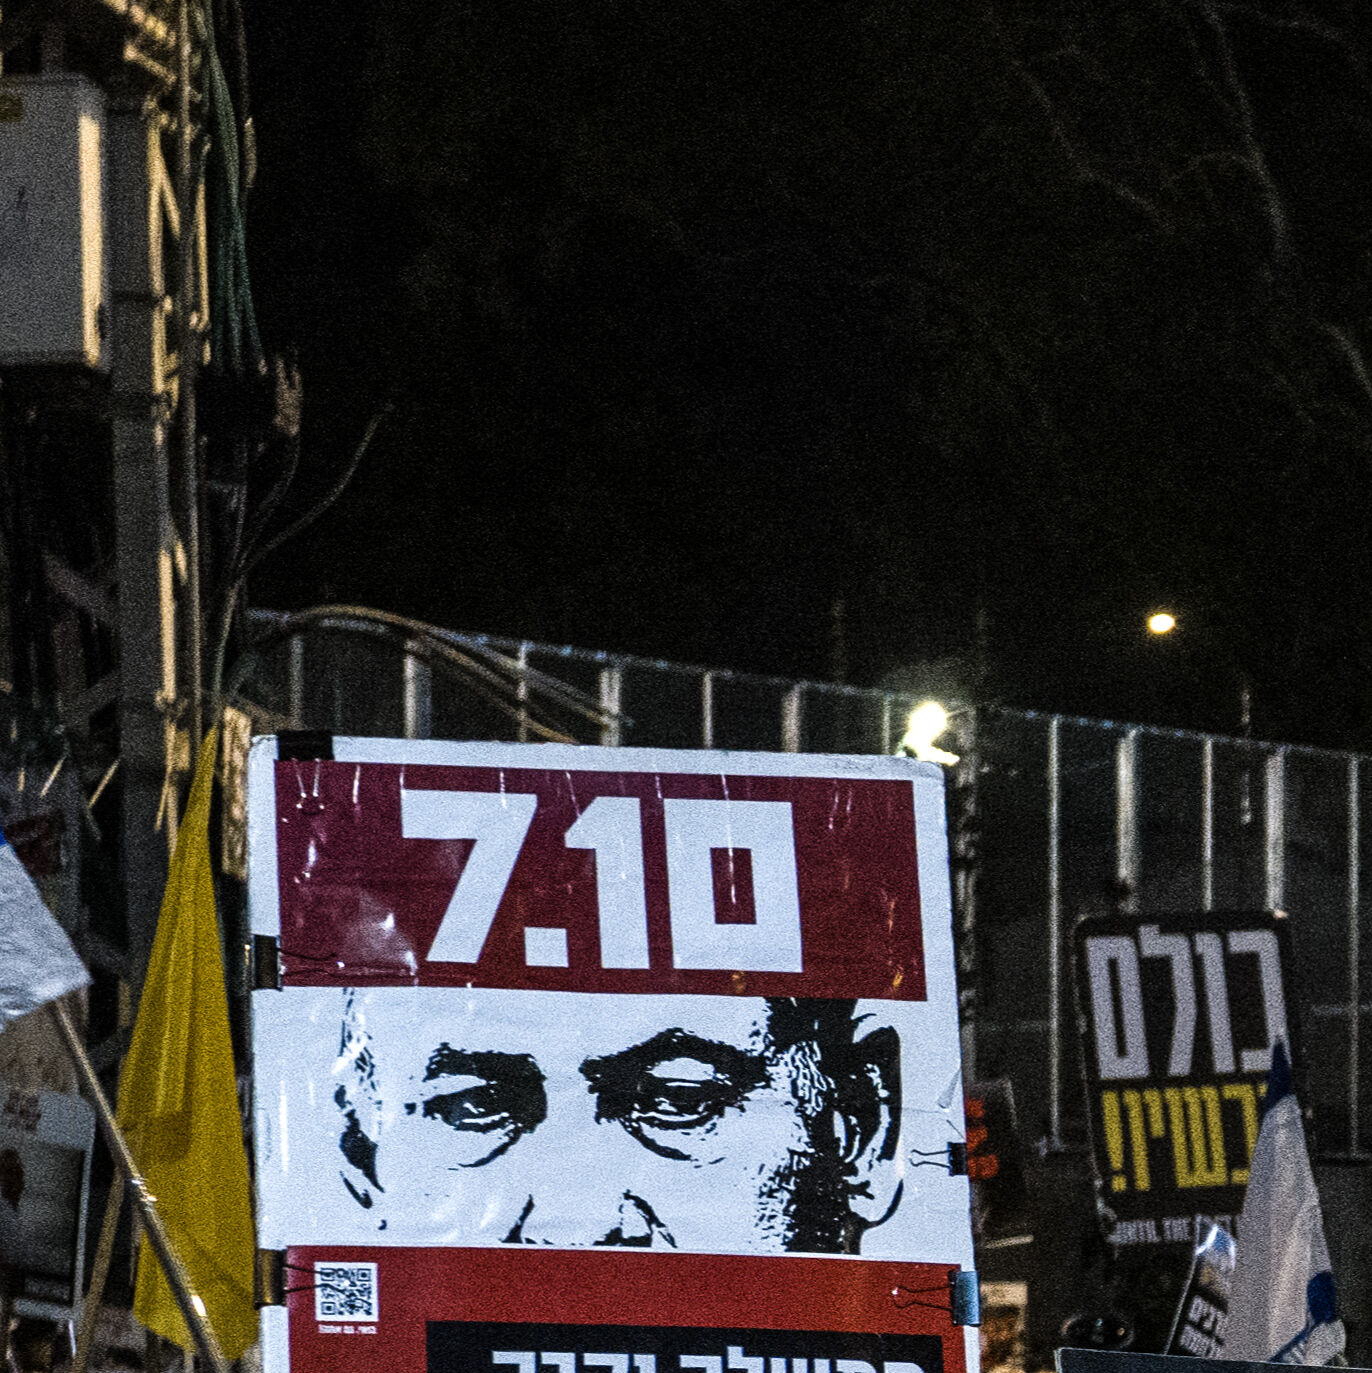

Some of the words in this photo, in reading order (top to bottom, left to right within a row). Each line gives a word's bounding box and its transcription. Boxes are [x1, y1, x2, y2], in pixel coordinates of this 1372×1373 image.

[401, 789, 803, 974] 7.10
[1085, 925, 1292, 1080] כולם
[1102, 1084, 1268, 1192] כשיו!
